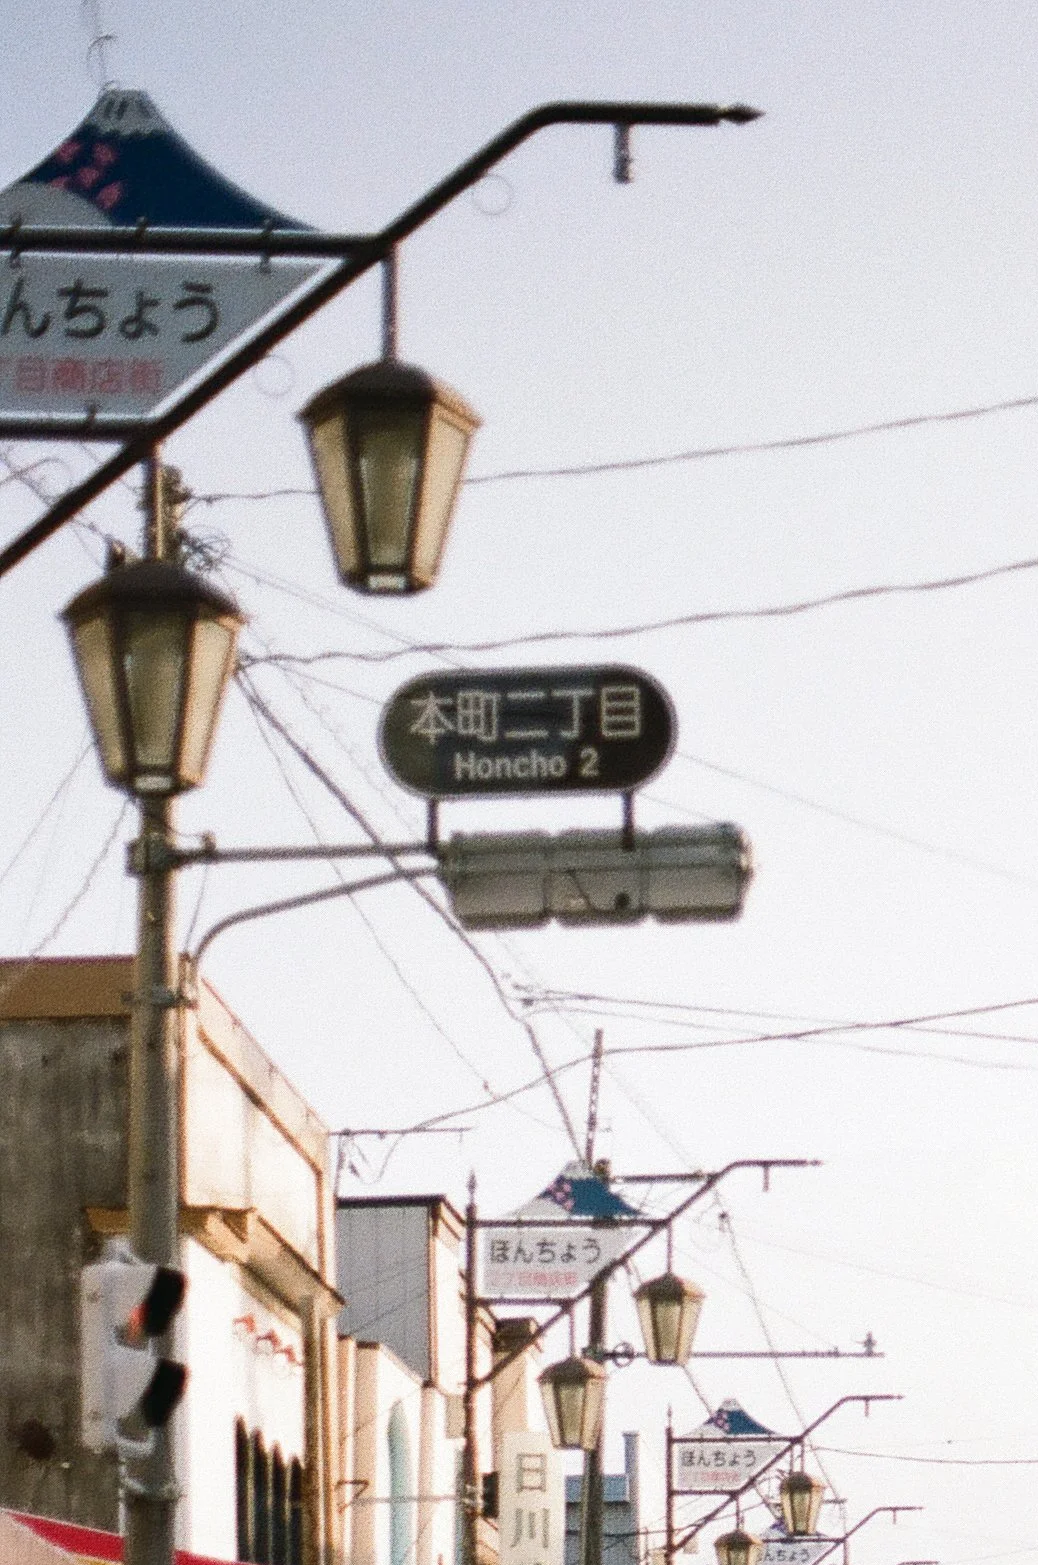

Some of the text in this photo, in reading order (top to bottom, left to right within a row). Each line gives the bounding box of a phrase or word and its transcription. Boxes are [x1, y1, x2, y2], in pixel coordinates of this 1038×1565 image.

[410, 685, 641, 745] 本町二丁目
[455, 746, 600, 782] Honcho 2
[490, 1238, 601, 1264] ほんちょう
[681, 1450, 757, 1468] ほんちょう
[764, 1549, 811, 1563] んちょう
